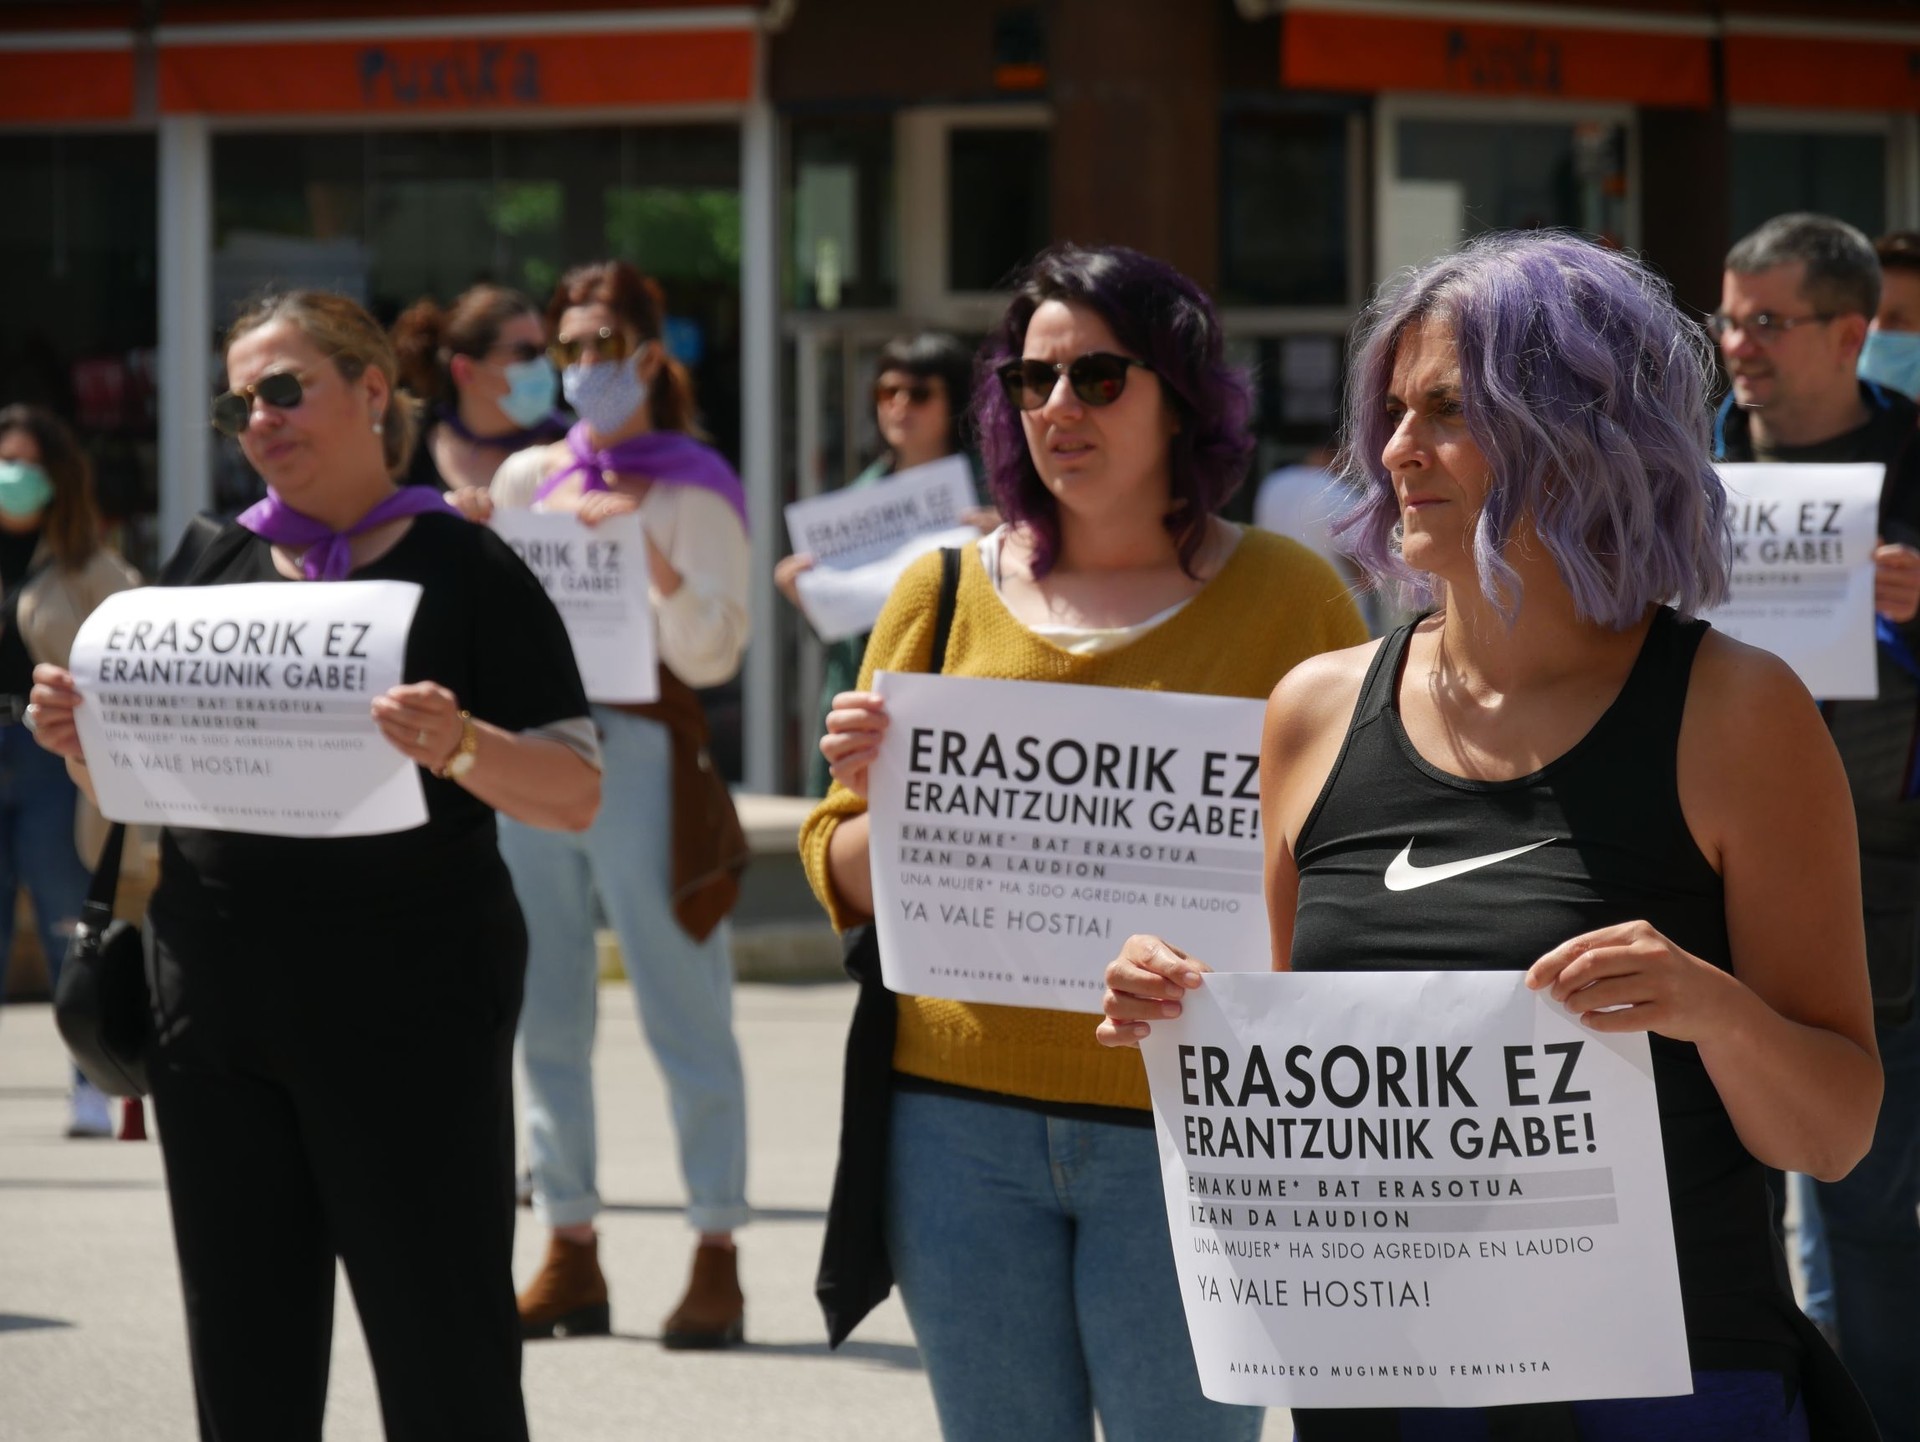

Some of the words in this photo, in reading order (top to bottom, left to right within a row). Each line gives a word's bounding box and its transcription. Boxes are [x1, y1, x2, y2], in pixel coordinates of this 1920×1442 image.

[1798, 502, 1842, 535] EZ
[1759, 539, 1844, 565] GABE!
[106, 619, 309, 658] ERASORIK
[324, 622, 372, 659] EZ
[99, 657, 272, 689] ERANTZUNIK
[283, 662, 367, 692] GABE!
[108, 750, 133, 769] YA
[140, 752, 183, 774] VALE
[191, 755, 272, 776] HOSTIA!
[908, 726, 1179, 794] ERASORIK
[1201, 750, 1260, 801] EZ
[904, 780, 1135, 829] ERANTZUNIK
[1149, 801, 1259, 840] GABE!
[901, 849, 953, 867] IZAN
[965, 853, 993, 869] DA
[1006, 855, 1107, 878] LAUDION
[1032, 836, 1071, 853] BAT
[1083, 841, 1199, 864] ERASOTUA
[900, 873, 932, 888] UNA
[1000, 880, 1023, 894] HA
[1028, 882, 1065, 899] SIDO
[1071, 887, 1149, 906] AGREDIDA
[1154, 893, 1175, 908] EN
[1181, 894, 1240, 914] LAUDIO
[899, 900, 929, 923] YA
[940, 904, 996, 929] VALE
[1007, 910, 1112, 939] HOSTIA!
[1178, 1043, 1479, 1108] ERASORIK
[1503, 1040, 1592, 1105] EZ
[1184, 1115, 1434, 1160] ERANTZUNIK
[1449, 1112, 1597, 1159] GABE!
[1318, 1180, 1361, 1198] BAT
[1378, 1177, 1524, 1198] ERASOTUA
[1191, 1206, 1234, 1227] IZAN
[1248, 1209, 1277, 1228] DA
[1293, 1210, 1411, 1229] LAUDION
[1193, 1237, 1220, 1256] UNA
[1289, 1242, 1314, 1259] HA
[1321, 1242, 1365, 1260] SIDO
[1373, 1241, 1472, 1260] AGREDIDA
[1480, 1240, 1507, 1258] EN
[1516, 1236, 1594, 1257] LAUDIO
[1197, 1273, 1222, 1304] YA
[1229, 1277, 1289, 1307] VALE
[1303, 1279, 1431, 1308] HOSTIA!
[1229, 1361, 1320, 1378] AIARALDEKO
[1331, 1363, 1438, 1378] MUGIMENDU
[1450, 1361, 1551, 1377] FEMINISTA
